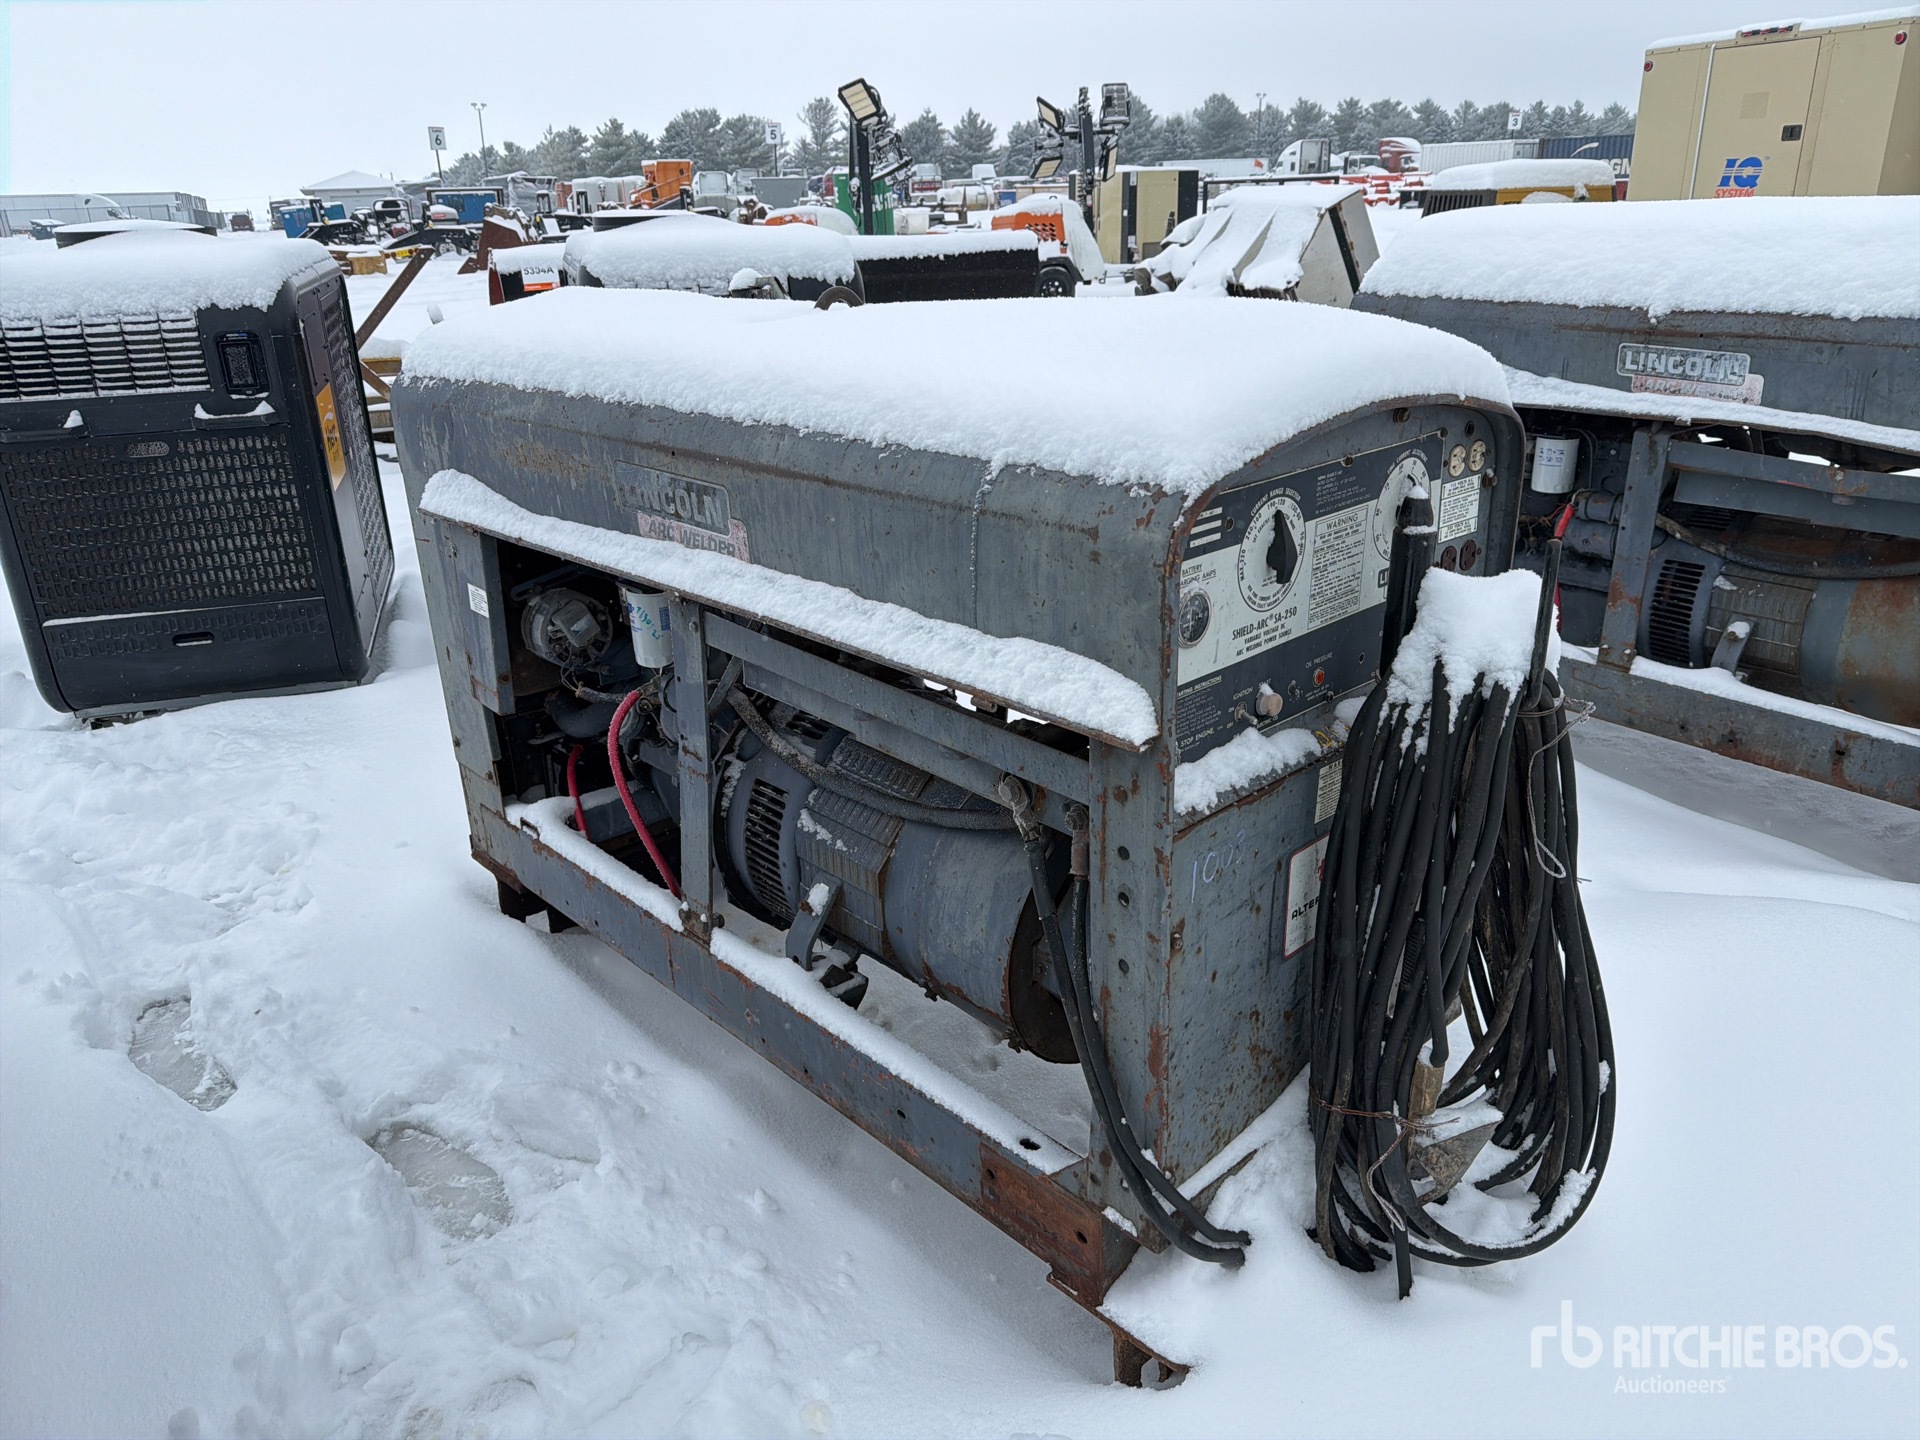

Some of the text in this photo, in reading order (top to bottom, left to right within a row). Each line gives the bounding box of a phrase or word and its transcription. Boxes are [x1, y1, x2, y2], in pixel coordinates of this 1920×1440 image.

[1512, 117, 1519, 127] 3
[435, 134, 442, 146] 6
[770, 129, 777, 140] 5
[1717, 156, 1763, 189] IQ
[1715, 188, 1756, 198] SYSTEM
[1625, 350, 1742, 381] LINCOLN
[630, 487, 724, 530] INCOLN
[1250, 494, 1269, 516] CURRENT
[1269, 487, 1284, 498] RANGE
[1326, 512, 1358, 530] WARNING
[649, 519, 736, 558] ARC WELDER
[1180, 568, 1217, 586] ARGING AMPS
[1182, 563, 1203, 576] BATTERY
[1274, 606, 1298, 624] SA-250
[1262, 625, 1280, 637] VOLTAGE
[1245, 640, 1263, 653] WELDING
[1263, 635, 1277, 645] POWER
[1233, 687, 1254, 701] IGNITION
[1180, 736, 1194, 747] STOP
[1195, 727, 1215, 741] ENGINE
